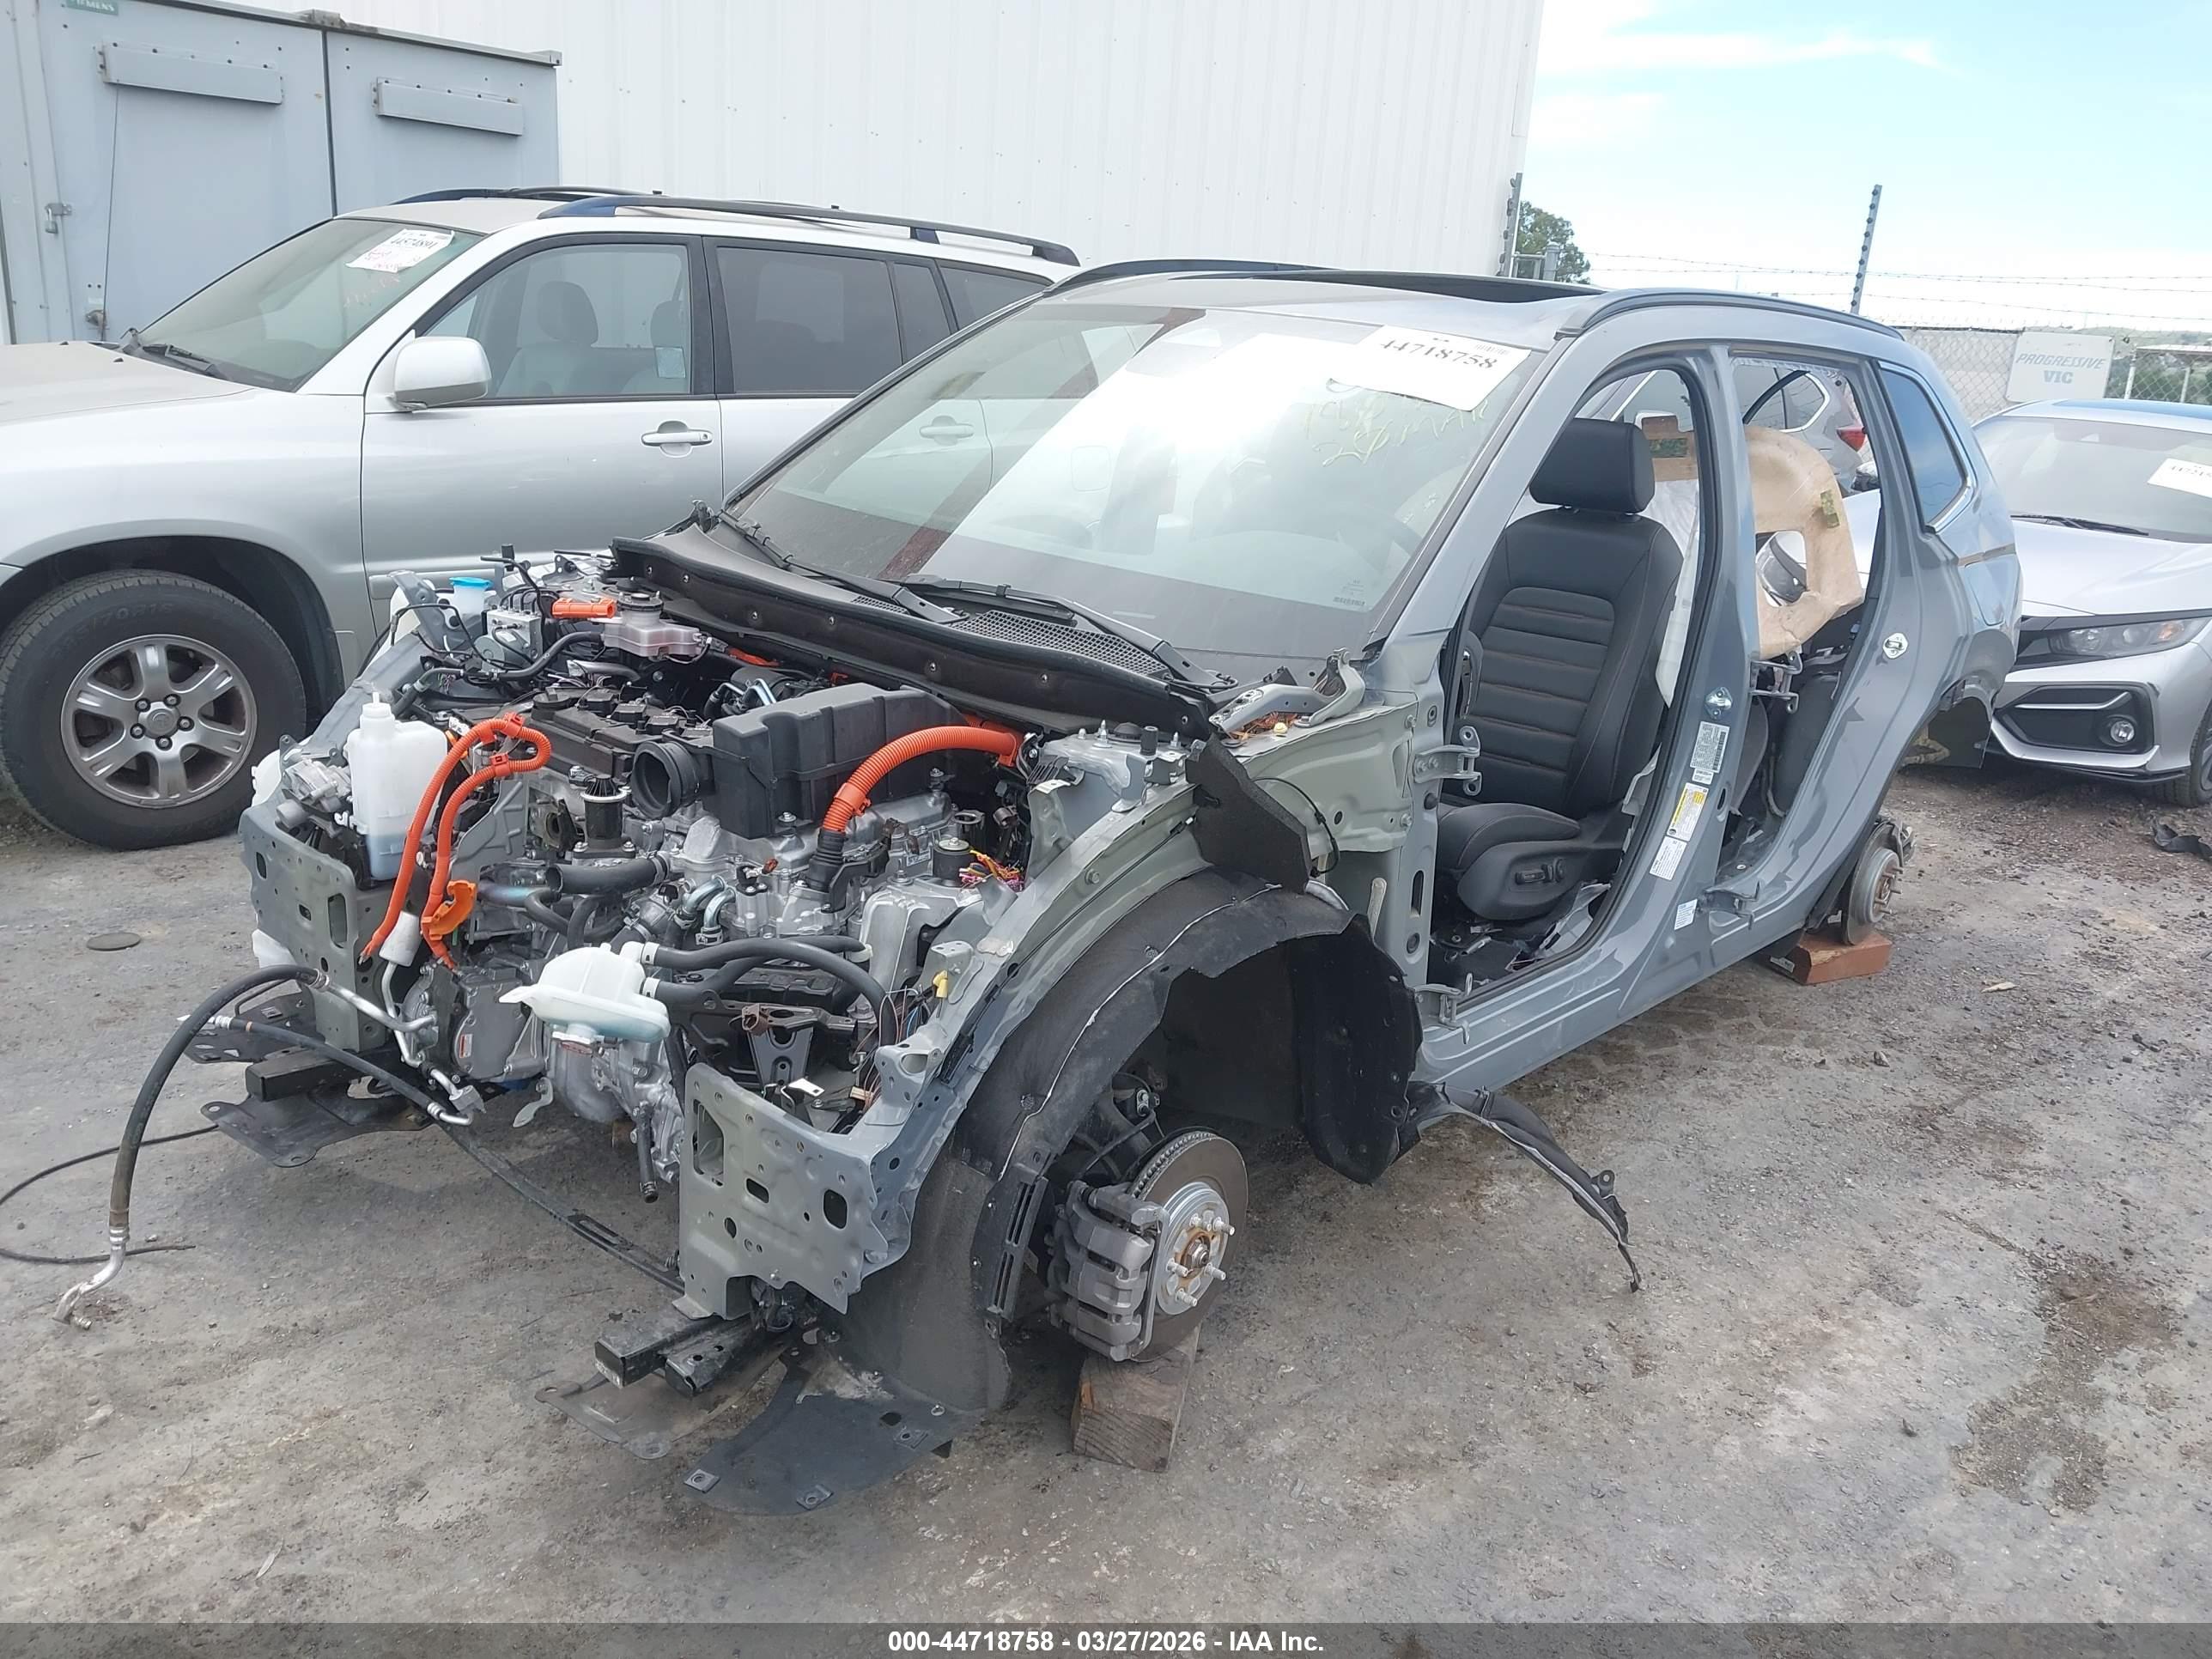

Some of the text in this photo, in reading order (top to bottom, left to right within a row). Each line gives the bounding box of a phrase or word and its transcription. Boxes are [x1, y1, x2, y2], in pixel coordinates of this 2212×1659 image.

[1381, 339, 1498, 369] 44718758
[2015, 353, 2106, 369] PROGRESSIVE
[2043, 369, 2074, 385] VIC
